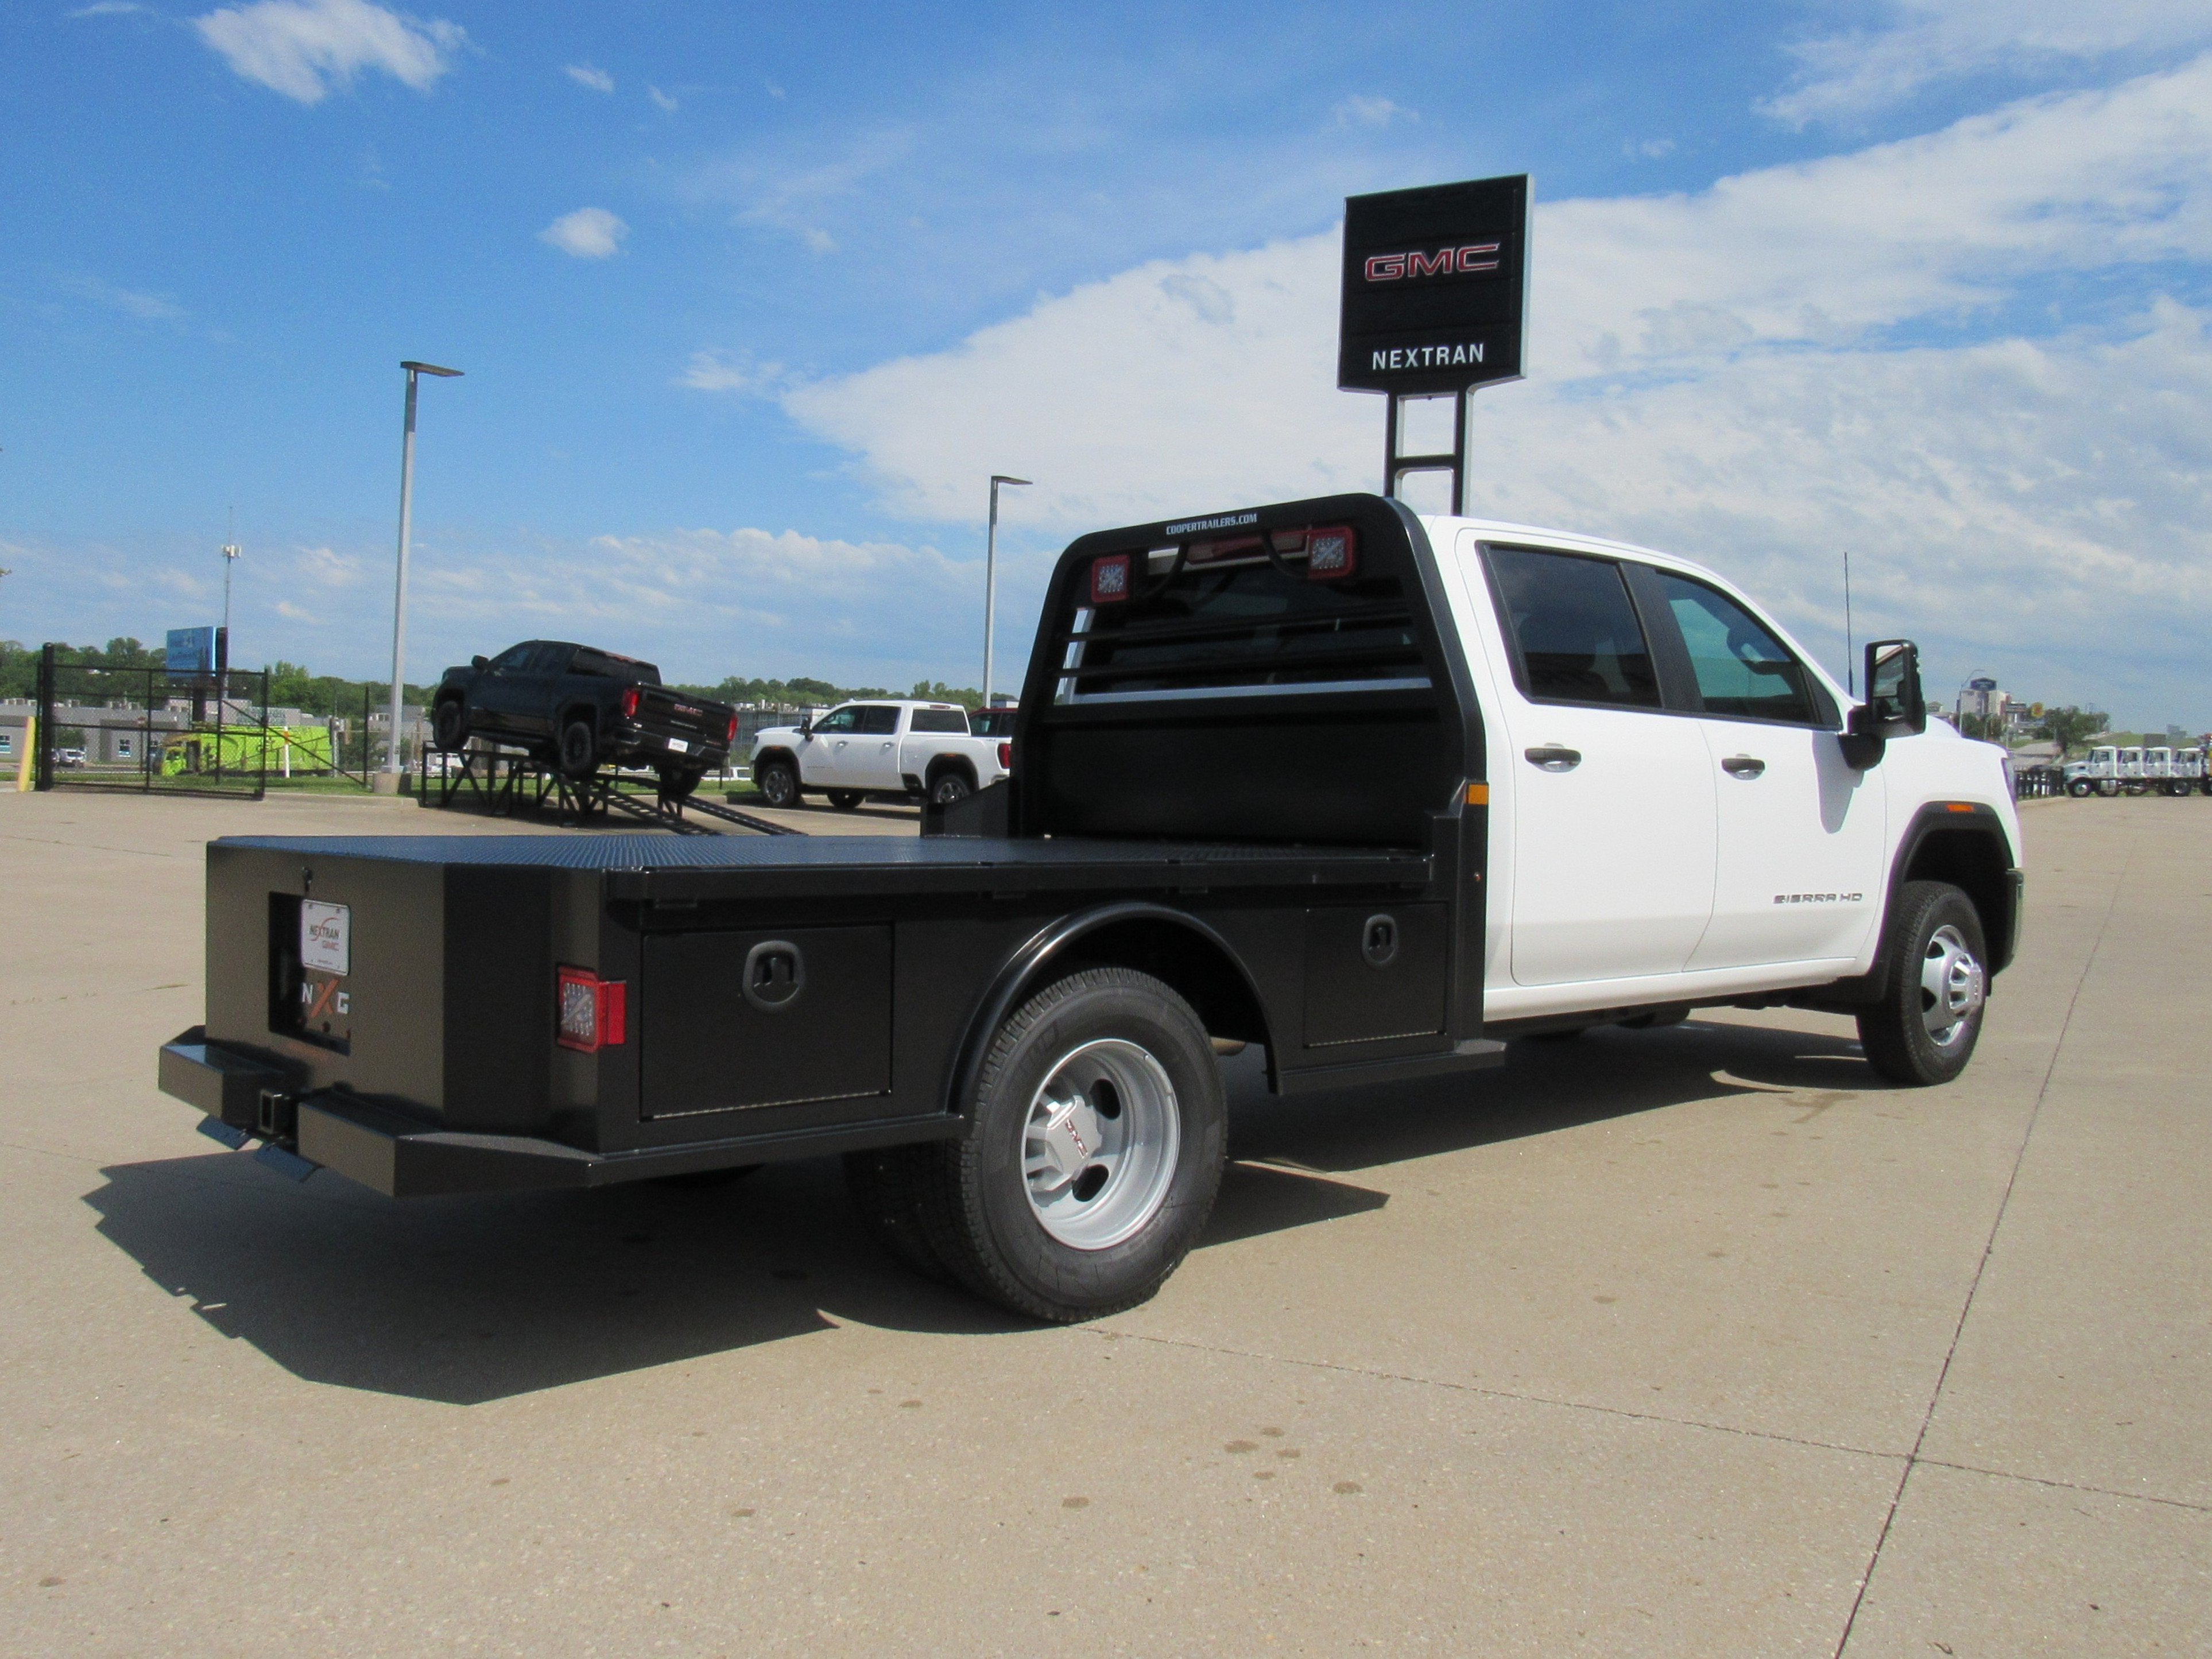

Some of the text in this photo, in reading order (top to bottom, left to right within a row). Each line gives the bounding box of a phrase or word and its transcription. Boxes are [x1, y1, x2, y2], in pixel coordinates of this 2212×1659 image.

[1365, 243, 1500, 281] GMC
[1372, 343, 1484, 370] NEXTRAN
[1166, 513, 1257, 535] COOPERTRAILERS.COM
[1773, 893, 1862, 904] SIERRA HD
